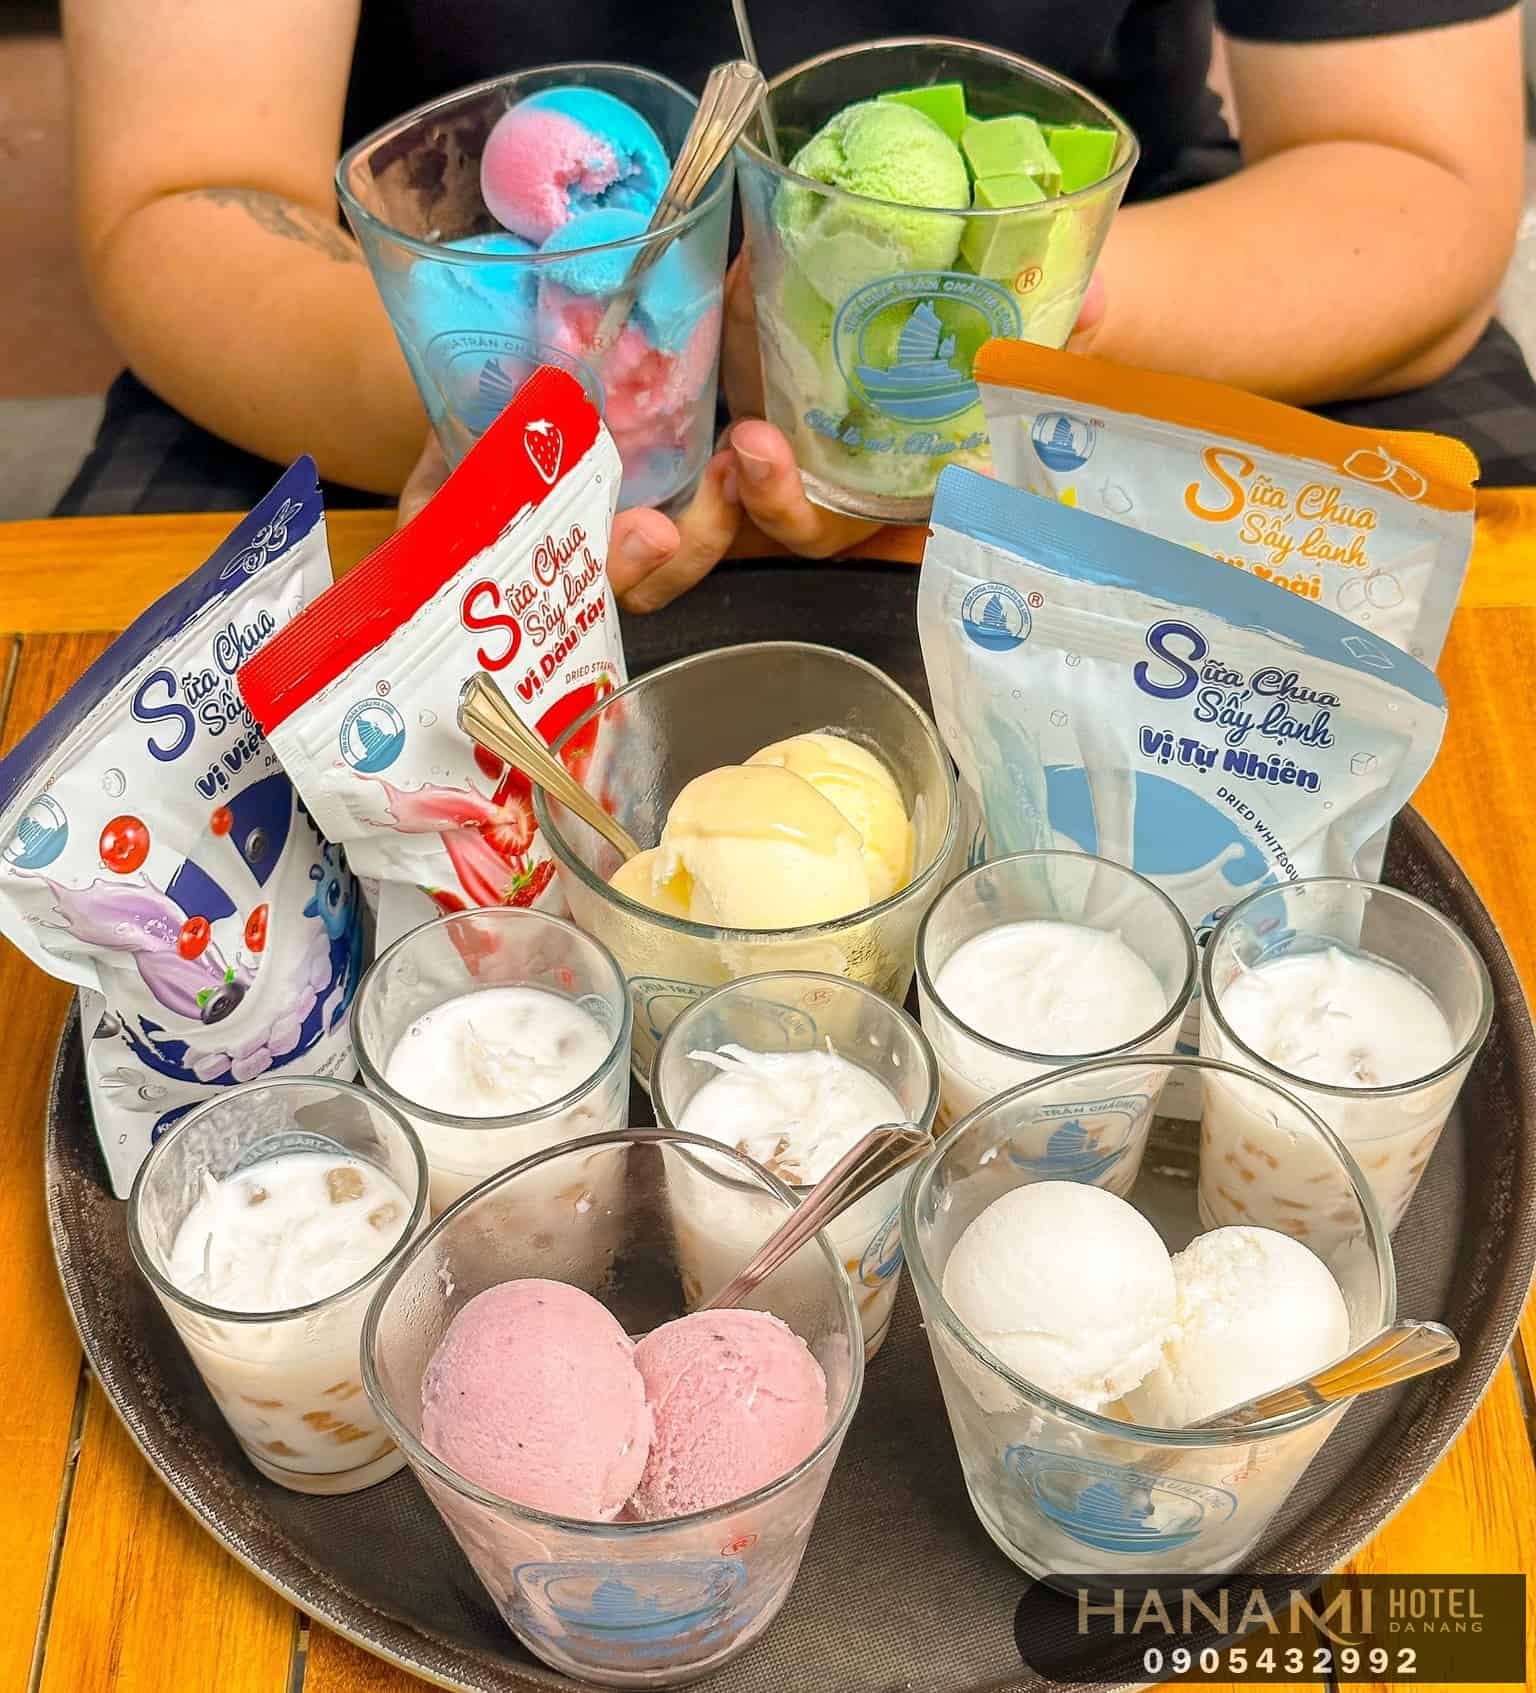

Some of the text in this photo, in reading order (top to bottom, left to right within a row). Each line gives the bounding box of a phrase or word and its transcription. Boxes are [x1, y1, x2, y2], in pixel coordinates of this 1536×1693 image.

[1184, 447, 1377, 530] Sữa Chua
[1239, 512, 1295, 565] Sấy
[463, 525, 587, 672] Sữa Chua
[525, 591, 567, 647] Sấy
[133, 614, 275, 762] Sữa Chua
[516, 668, 544, 701] Vị
[1133, 620, 1341, 709] Sữa Chua
[1194, 688, 1257, 746] Sấy
[197, 764, 229, 797] Vị
[1140, 726, 1321, 791] Vị Tự Nhiên
[1216, 787, 1256, 821] DRIED
